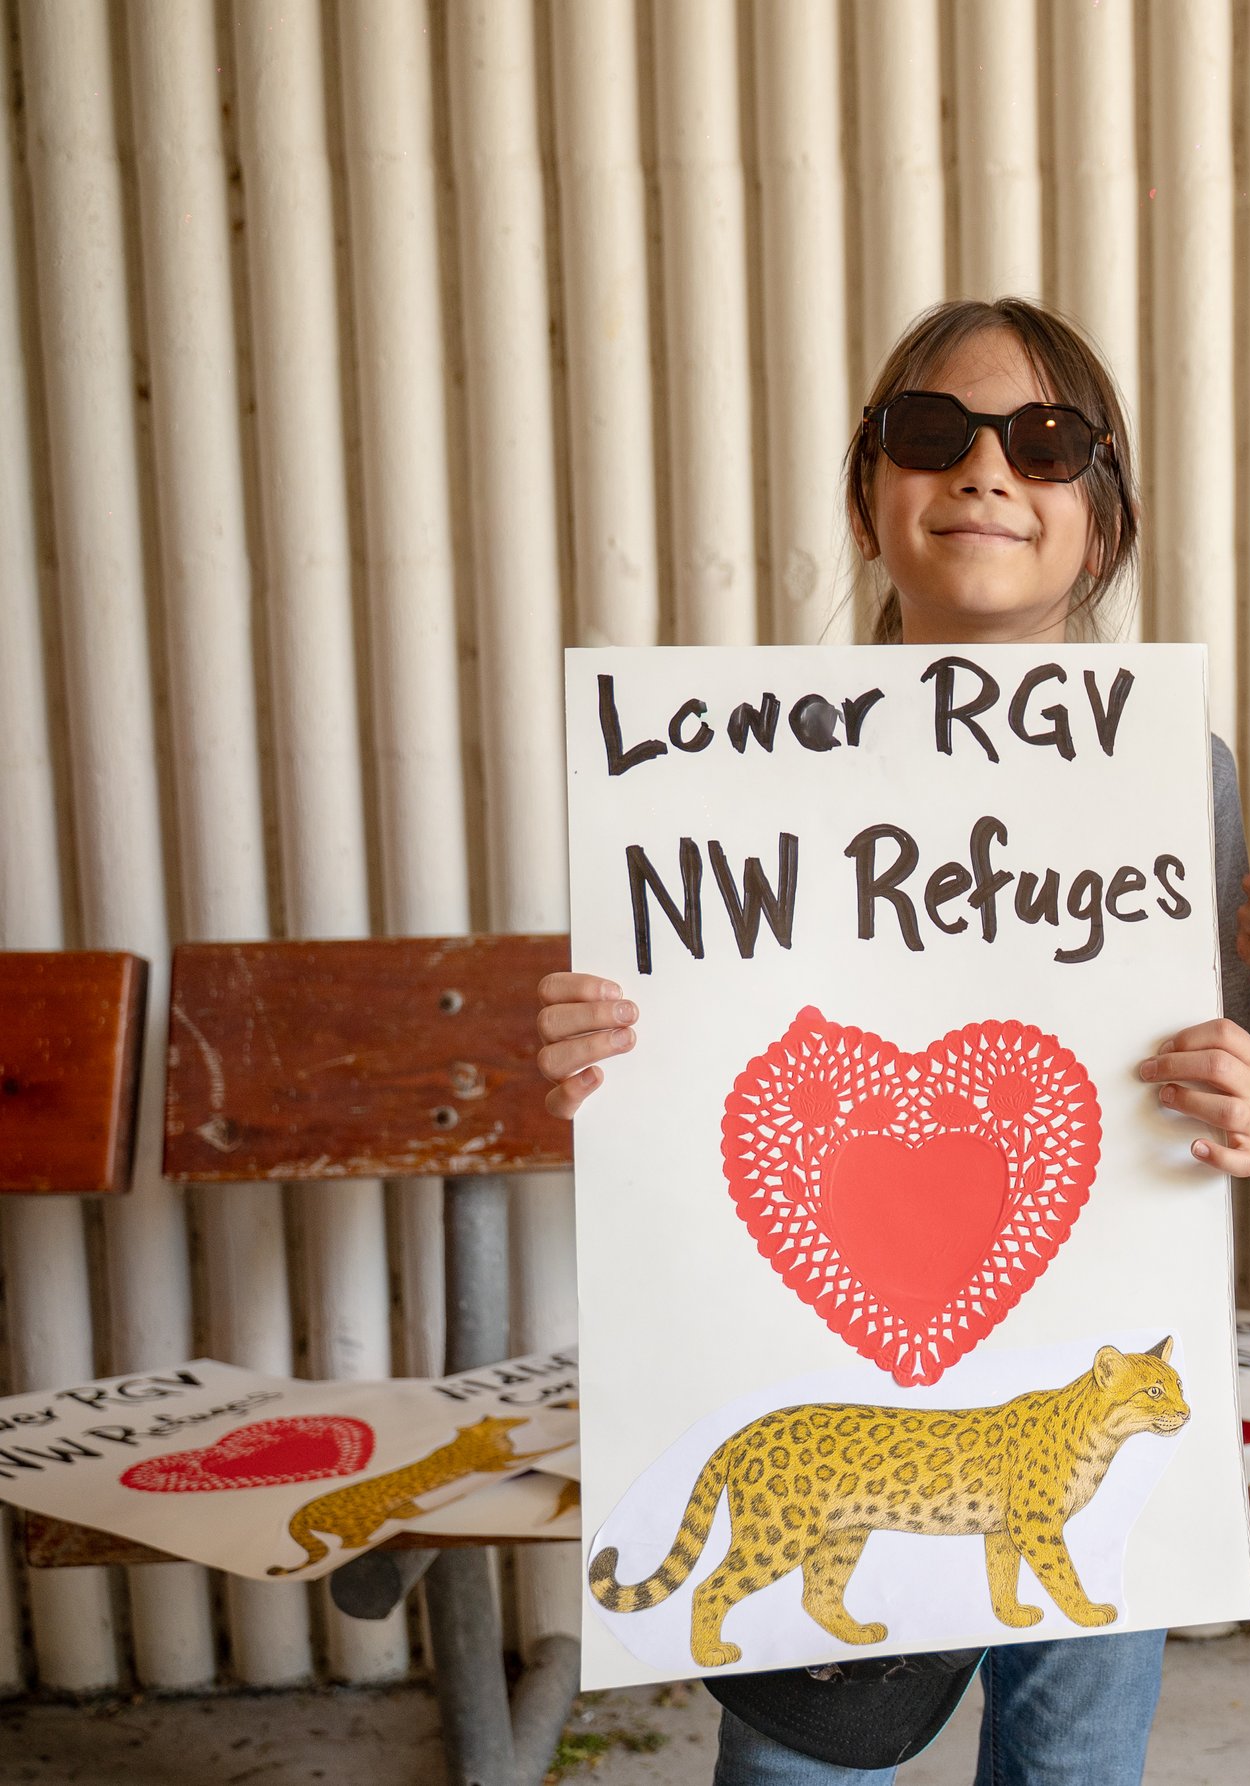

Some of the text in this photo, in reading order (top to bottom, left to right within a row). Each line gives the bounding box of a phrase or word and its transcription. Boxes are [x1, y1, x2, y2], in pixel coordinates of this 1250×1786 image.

[920, 655, 1136, 764] RGV
[625, 815, 1192, 976] NW Refuges
[56, 1369, 203, 1410] RGV
